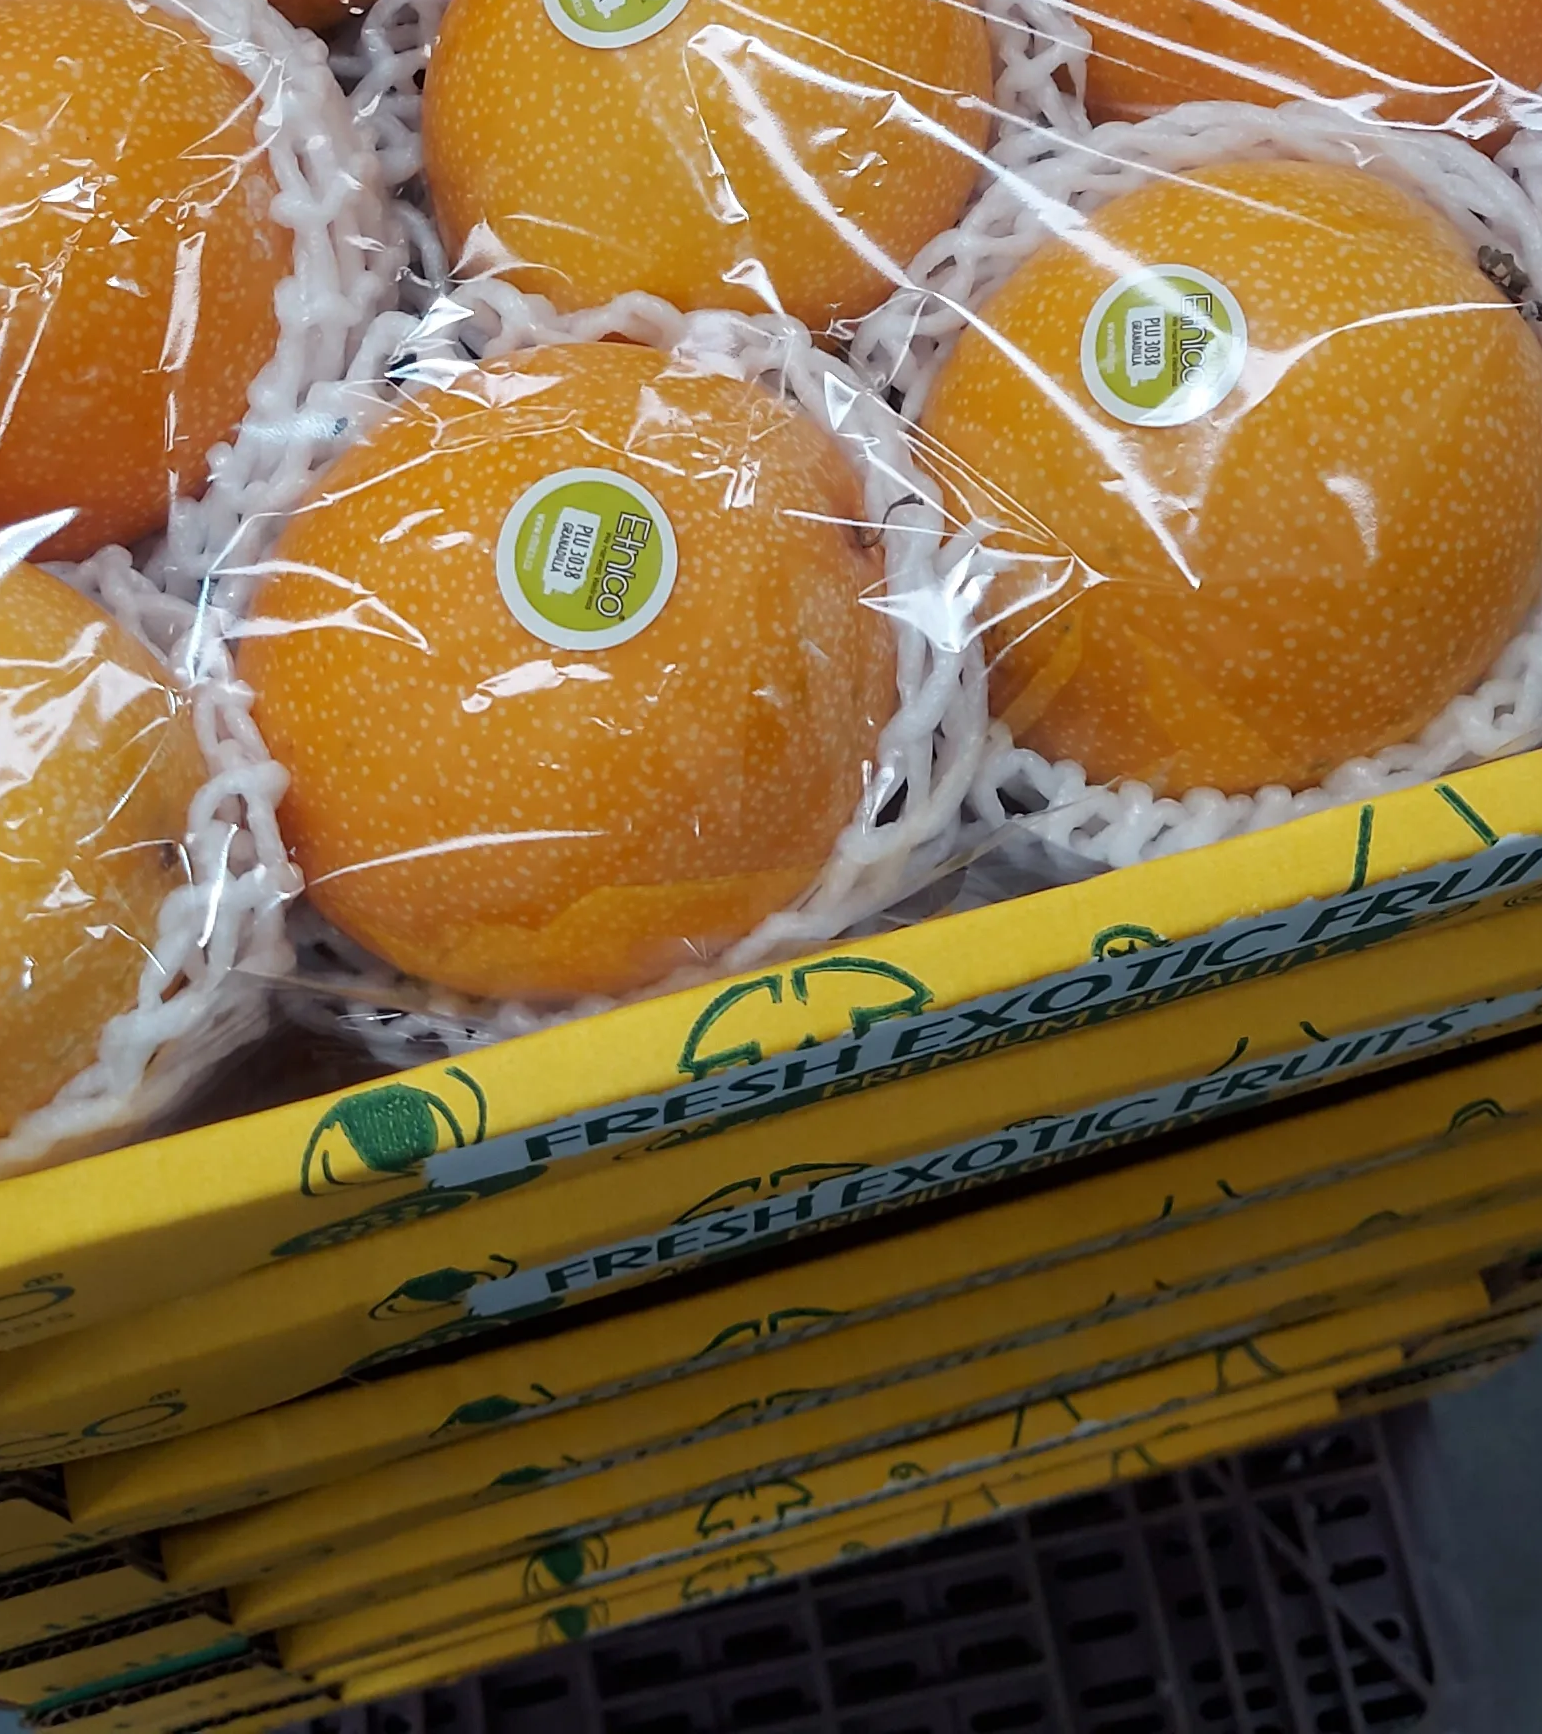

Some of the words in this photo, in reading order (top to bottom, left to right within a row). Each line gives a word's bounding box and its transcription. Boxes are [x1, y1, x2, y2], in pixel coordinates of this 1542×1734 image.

[1131, 320, 1142, 367] GRANADILLA
[1144, 317, 1161, 338] PLU
[1144, 339, 1161, 367] 3038
[550, 521, 575, 573] GRANADILLA
[572, 523, 594, 549] PLU
[564, 548, 587, 580] 3038
[596, 512, 652, 618] Etnico
[526, 1044, 862, 1162] FRESH
[892, 922, 1287, 1060] EXOTIC
[820, 1012, 1087, 1099] PREMIUM
[1105, 937, 1349, 1017] QUALITY
[545, 1194, 815, 1296] FRESH
[839, 1097, 1159, 1211] EXOTIC
[1174, 1007, 1469, 1113] FRUITS
